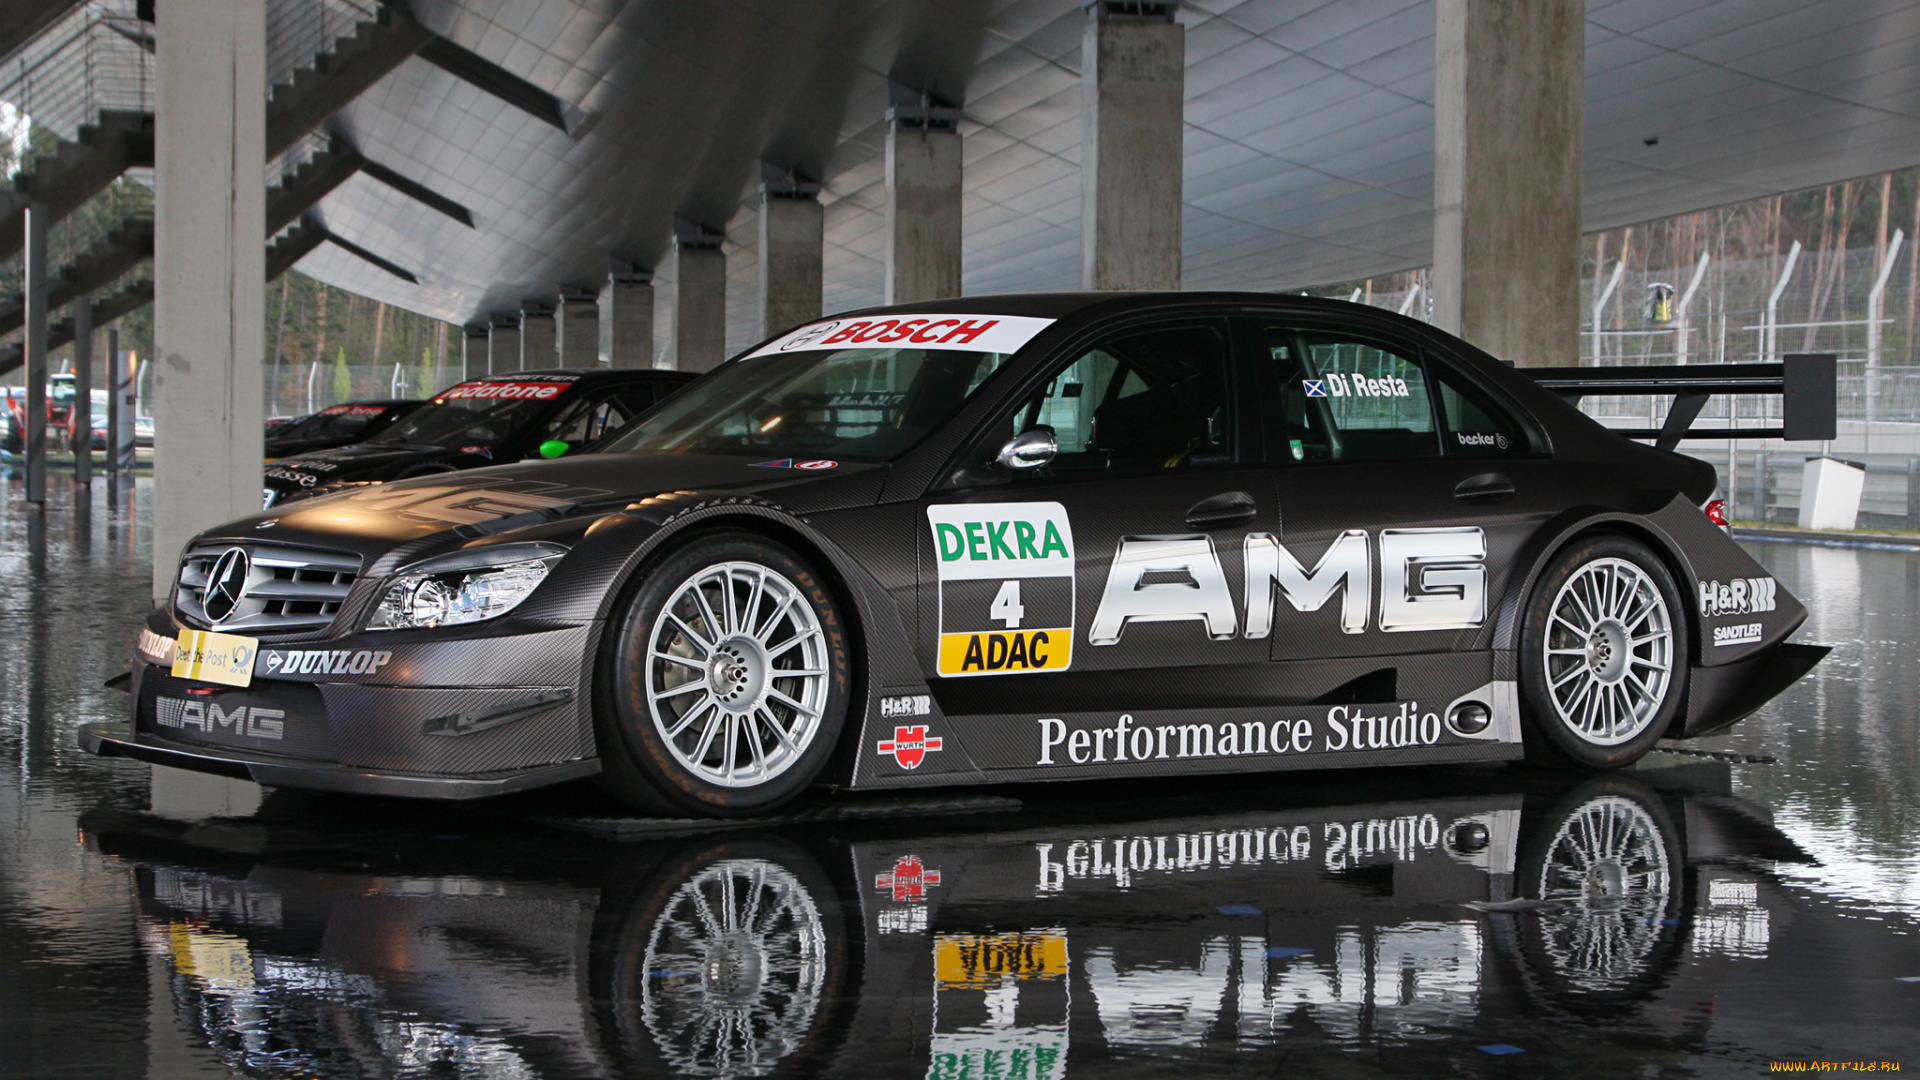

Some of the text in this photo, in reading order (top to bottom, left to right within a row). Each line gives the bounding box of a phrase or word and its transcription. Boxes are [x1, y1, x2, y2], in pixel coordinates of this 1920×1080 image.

[820, 318, 1000, 344] BOSCH
[1326, 373, 1410, 397] Di Resta
[1457, 432, 1495, 446] becker
[935, 518, 1069, 562] DEKRA
[1088, 526, 1488, 646] AMG
[1699, 579, 1750, 617] H&R
[989, 580, 1025, 629] 4
[1713, 623, 1762, 641] SANDTLER
[175, 645, 228, 668] Deutsche Post
[279, 650, 393, 675] DUNLOP
[961, 631, 1049, 671] ADAC
[179, 701, 286, 740] AMG
[880, 696, 914, 717] H&R
[1036, 702, 1441, 765] Performance Studio
